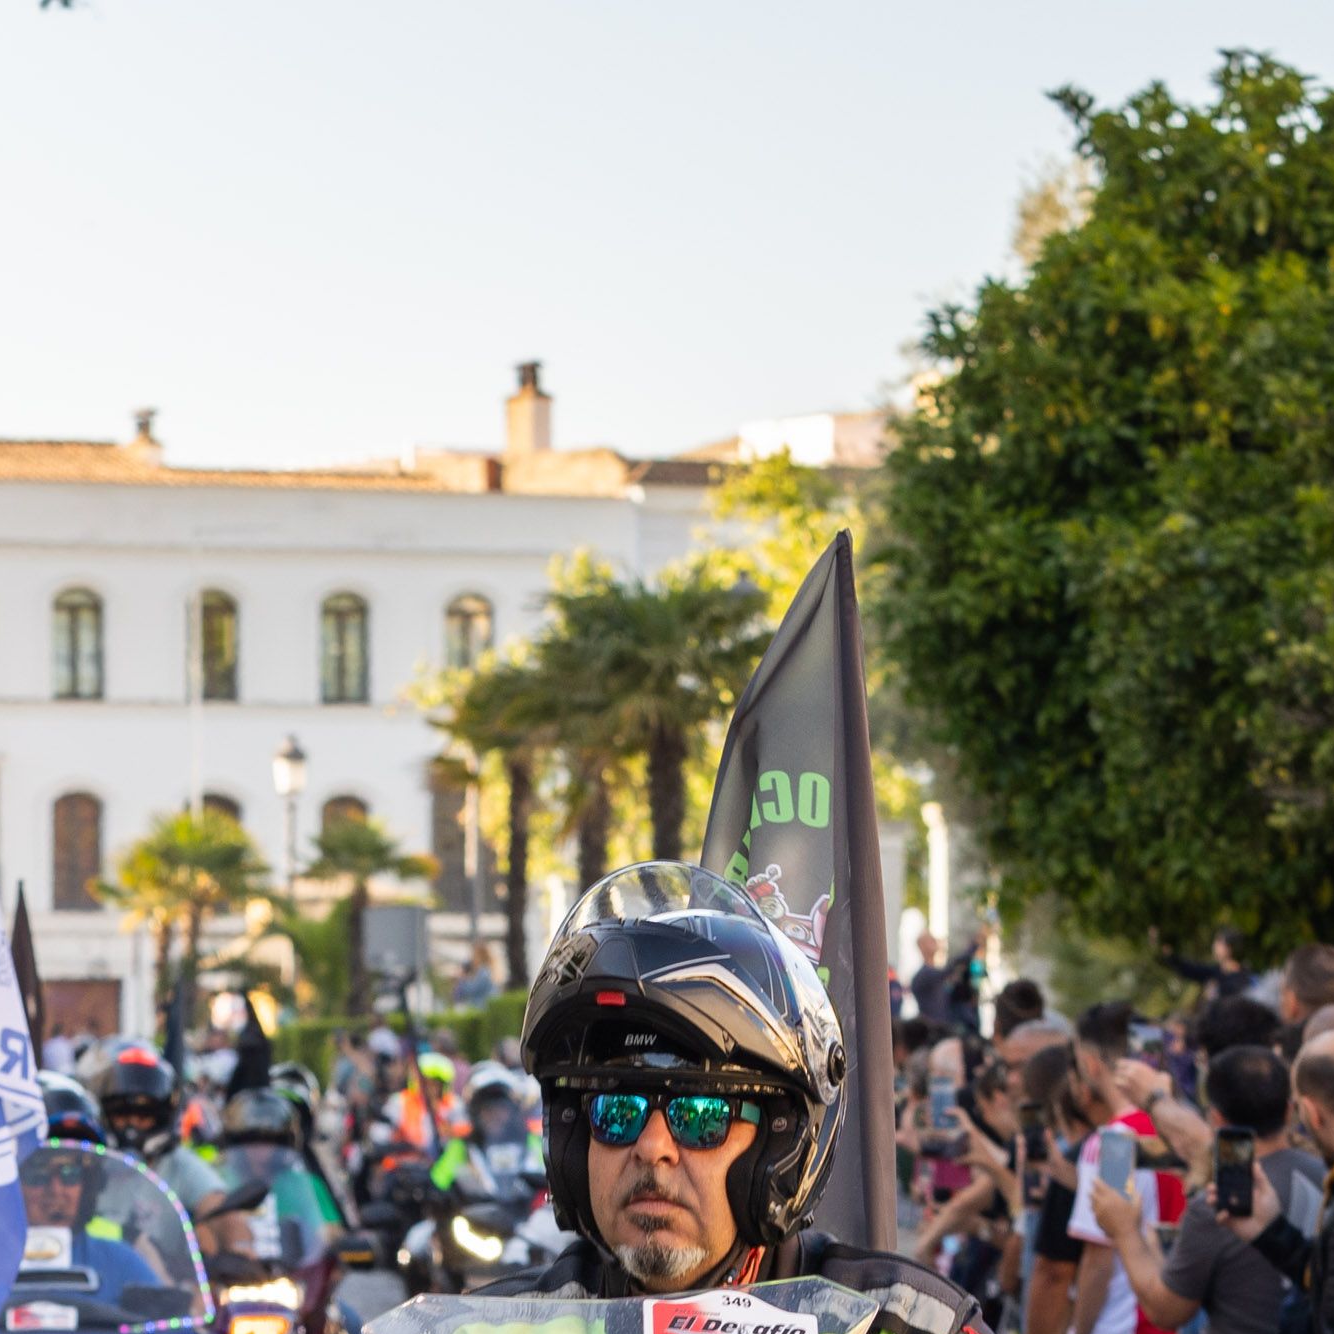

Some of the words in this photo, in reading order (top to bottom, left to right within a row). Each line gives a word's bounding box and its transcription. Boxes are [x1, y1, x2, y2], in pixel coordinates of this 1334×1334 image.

[624, 1033, 657, 1046] BMW
[721, 1295, 752, 1308] 349
[668, 1316, 697, 1330] El
